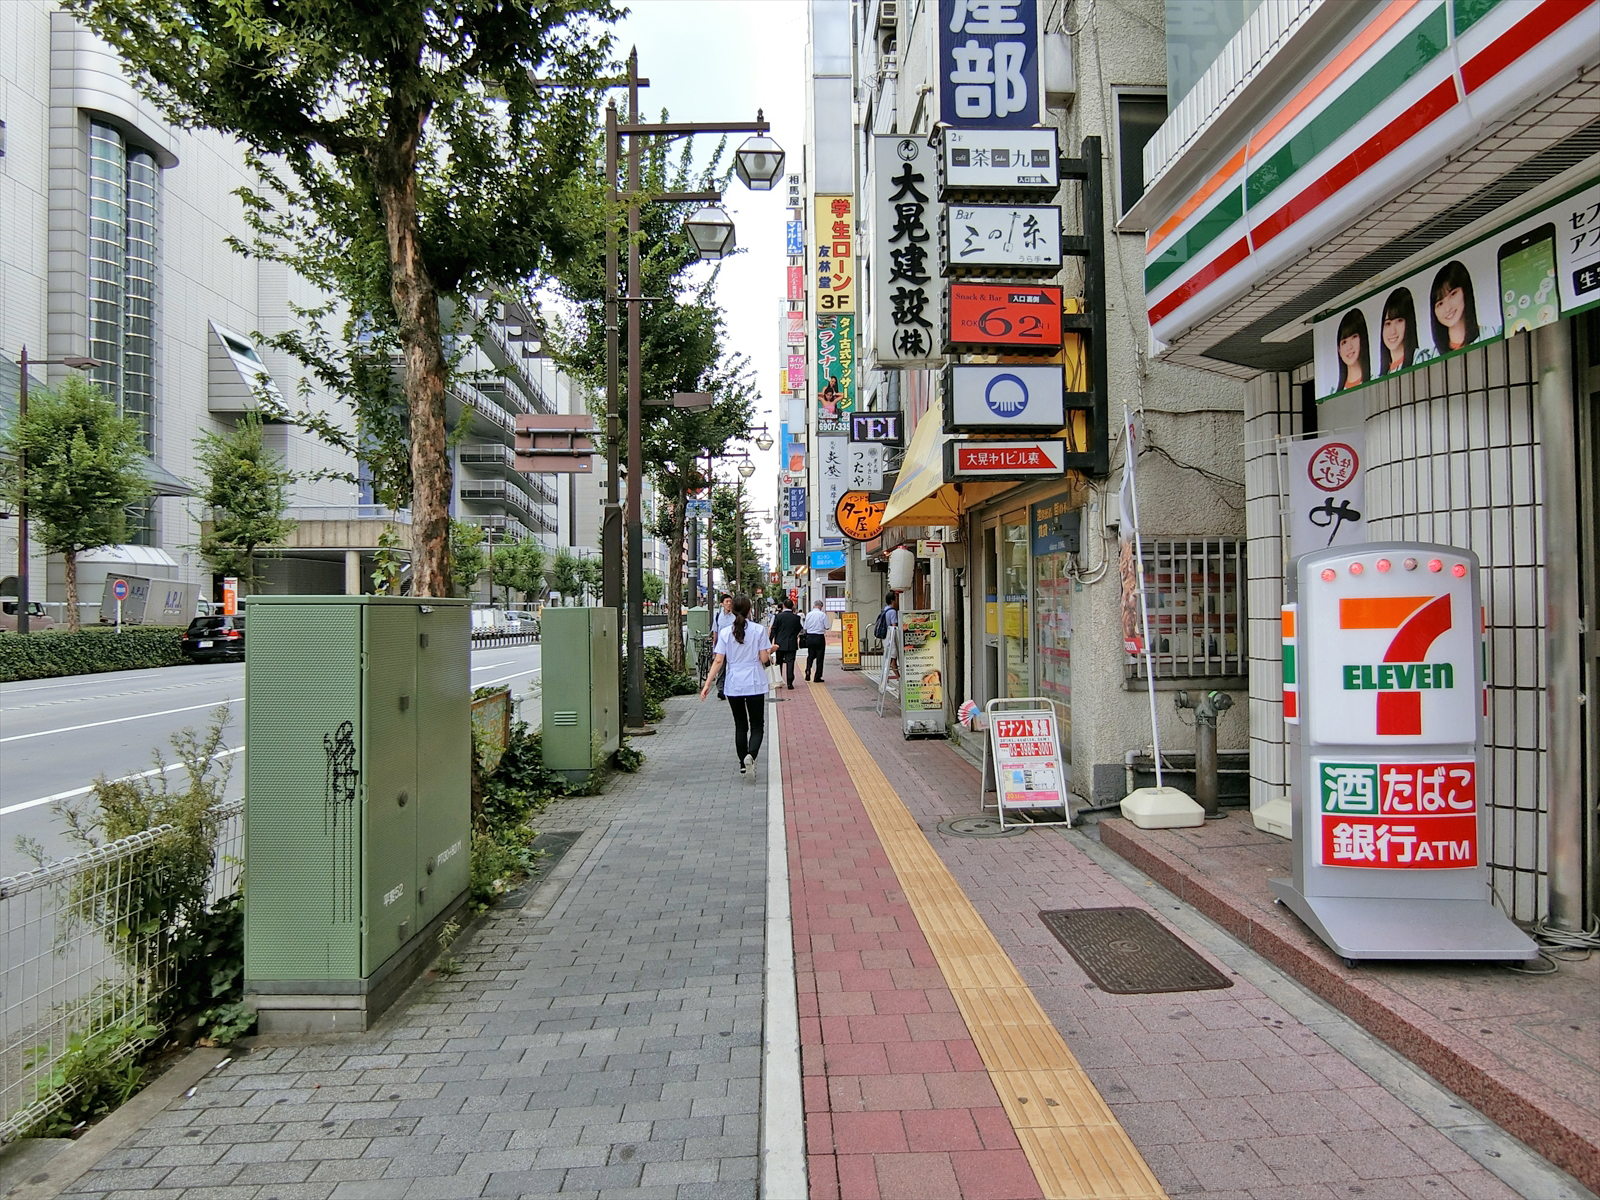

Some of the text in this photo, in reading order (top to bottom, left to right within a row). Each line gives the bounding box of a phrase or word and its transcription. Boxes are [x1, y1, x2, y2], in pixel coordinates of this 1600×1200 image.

[951, 133, 963, 142] 2F
[971, 148, 990, 168] 茶
[1011, 149, 1030, 168] 九
[956, 209, 974, 220] Bar
[830, 199, 851, 292] 学生ローン
[818, 245, 831, 289] 友林堂
[1580, 267, 1600, 290] 生
[821, 294, 849, 309] 3F
[955, 292, 978, 301] Snack
[989, 294, 1002, 302] Bar
[961, 319, 985, 328] ROKU
[978, 307, 1043, 338] 62
[818, 330, 837, 380] ランナー
[839, 317, 852, 409] タイ古式マッサージ
[853, 452, 864, 487] つたや
[841, 502, 885, 519] ターリー
[844, 526, 861, 538] CURRY
[855, 516, 868, 532] 屋
[1000, 719, 1049, 736] テナント募集
[1323, 766, 1473, 811] 酒 たばこ
